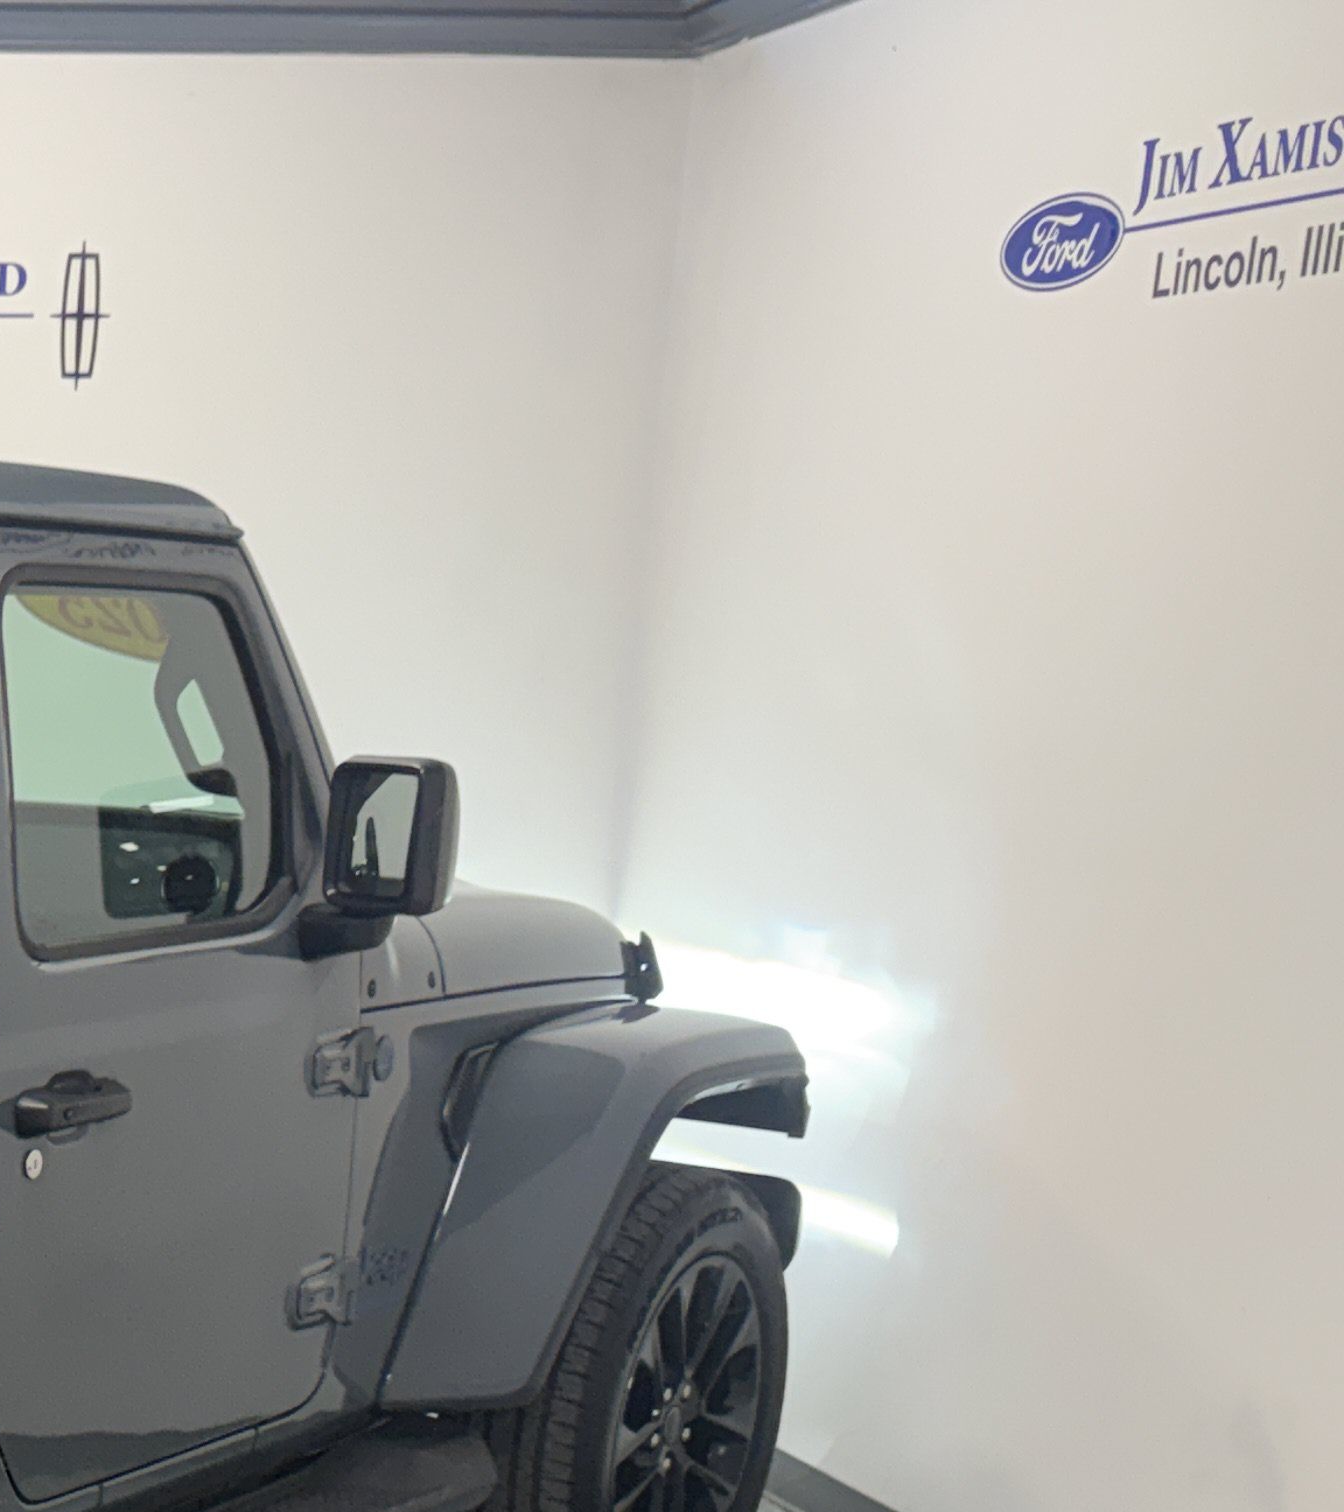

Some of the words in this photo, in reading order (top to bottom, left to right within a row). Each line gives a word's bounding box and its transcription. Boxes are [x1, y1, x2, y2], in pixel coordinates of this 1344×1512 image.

[1133, 138, 1202, 216] JIM
[1208, 115, 1344, 189] XAMIS
[1021, 212, 1100, 277] Ford
[1152, 236, 1286, 299] Lincoln,
